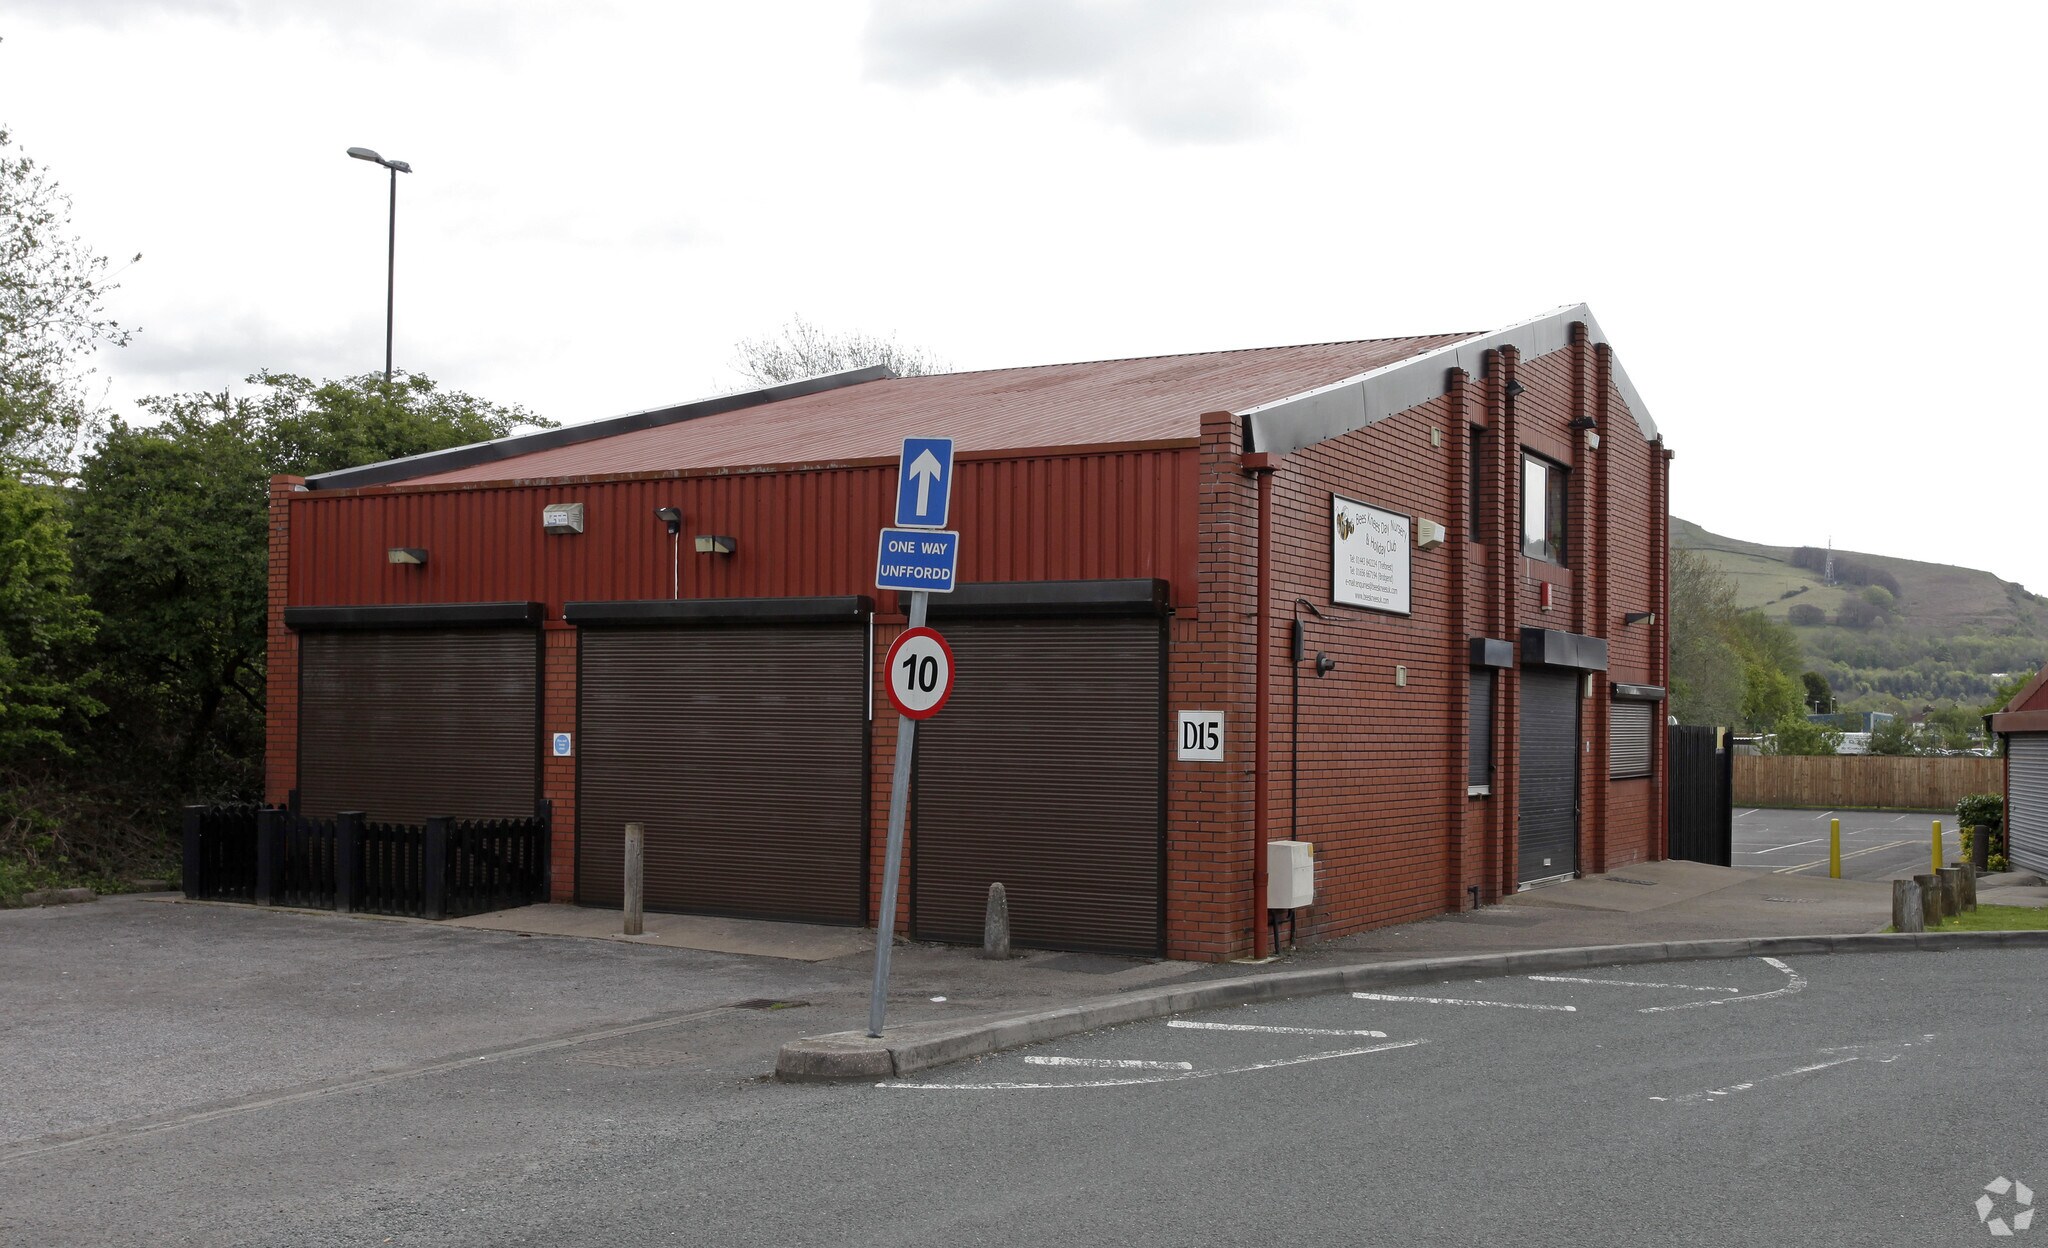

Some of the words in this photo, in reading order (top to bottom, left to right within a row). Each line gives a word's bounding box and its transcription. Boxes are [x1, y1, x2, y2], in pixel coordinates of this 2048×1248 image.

[1356, 513, 1366, 526] Bees
[1367, 512, 1380, 534] Knees
[1381, 522, 1390, 536] Day
[1391, 520, 1408, 543] Nursery
[889, 541, 915, 553] ONE
[921, 542, 948, 554] WAY
[1366, 533, 1370, 546] &
[1370, 536, 1387, 557] Holiday
[1387, 540, 1397, 552] Club
[881, 565, 950, 580] UNFFORDD
[903, 654, 938, 692] 10
[1183, 721, 1219, 750] D15
